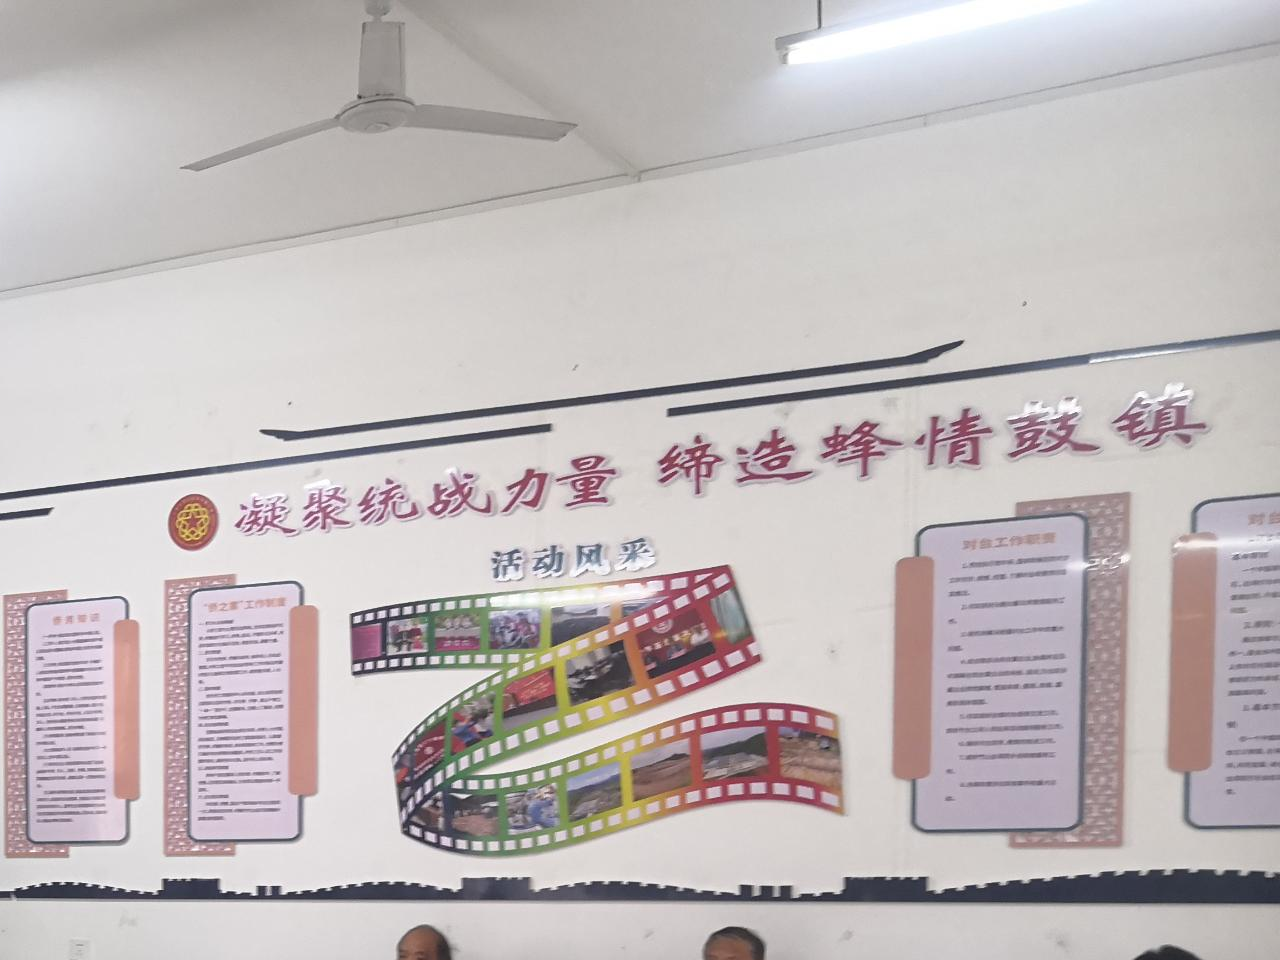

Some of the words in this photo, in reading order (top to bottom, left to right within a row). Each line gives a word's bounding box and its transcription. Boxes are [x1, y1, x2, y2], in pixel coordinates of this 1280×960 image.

[234, 455, 618, 535] 凝聚统战力量
[656, 384, 1207, 495] 缔造蜂情鼓镇
[490, 537, 656, 581] 活动风采
